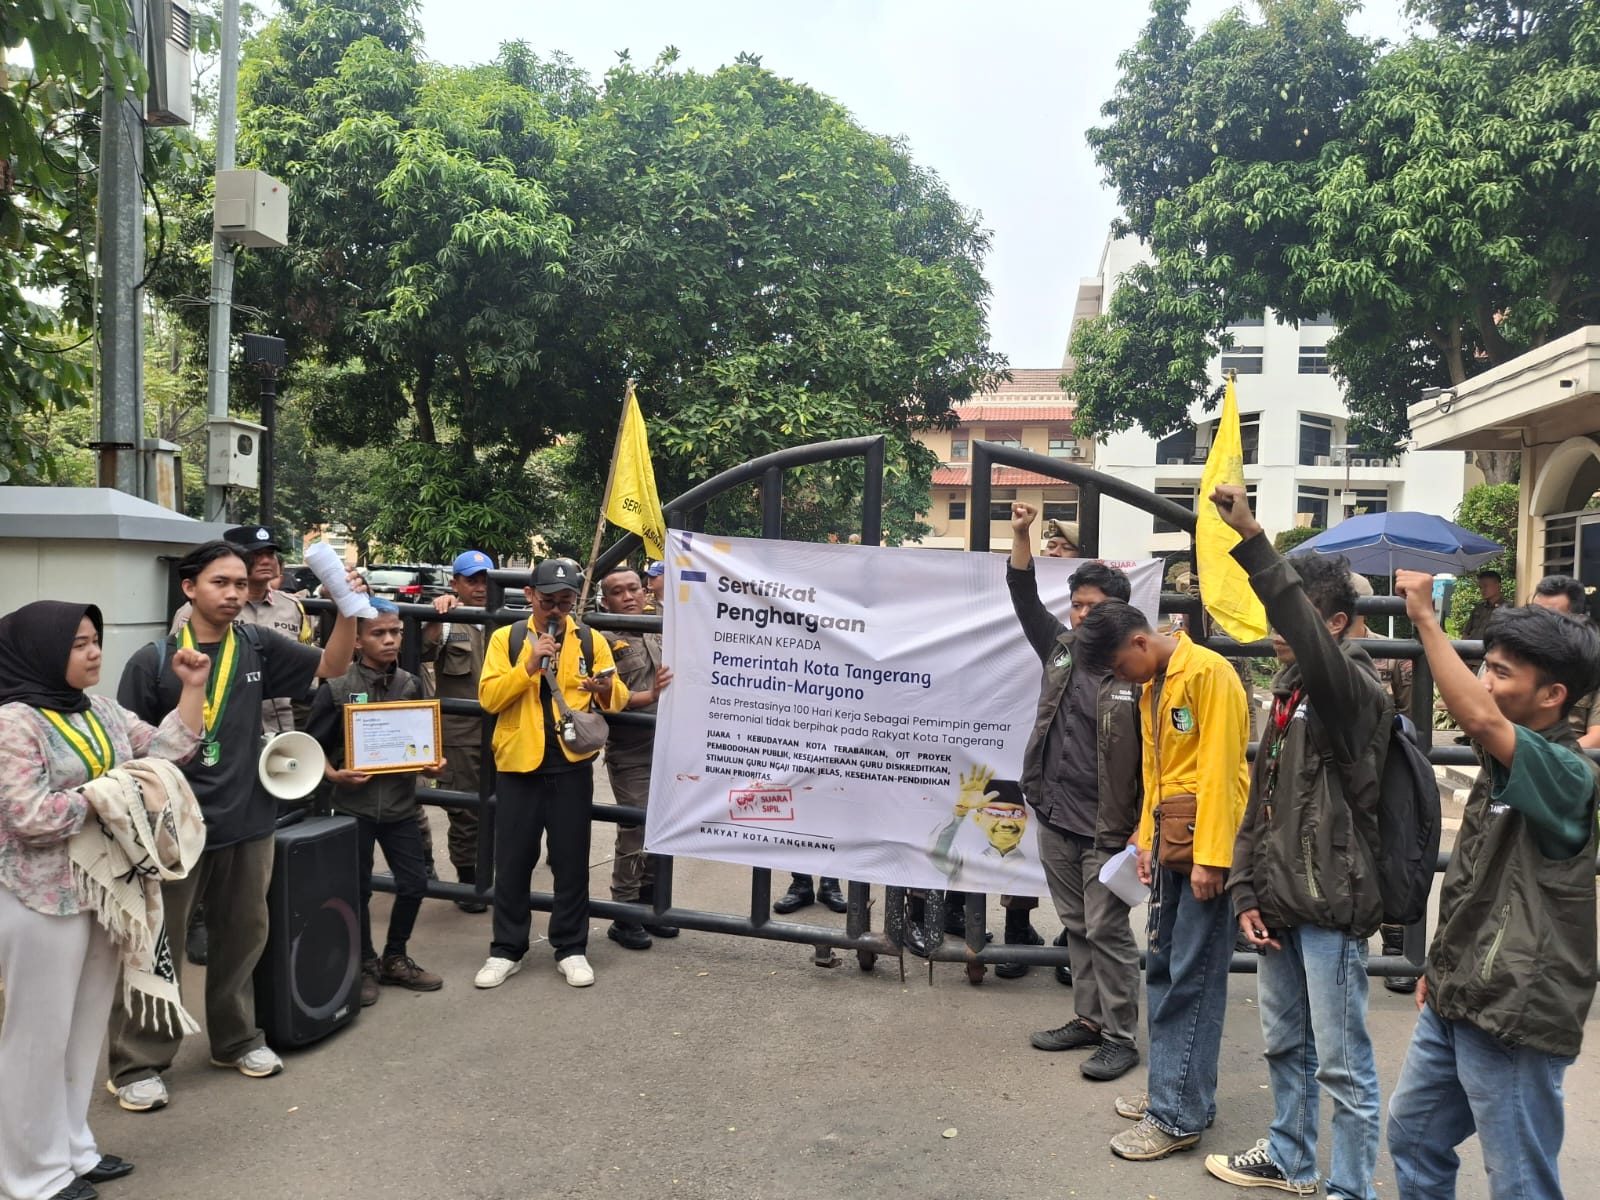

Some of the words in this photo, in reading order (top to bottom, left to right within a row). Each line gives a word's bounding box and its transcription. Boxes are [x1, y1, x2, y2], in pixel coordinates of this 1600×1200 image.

[1110, 561, 1136, 569] SUARA
[718, 576, 817, 603] Sertifikat
[716, 602, 866, 634] Penghargaan
[714, 631, 773, 647] DIBERIKAN
[775, 636, 821, 651] KEPADA
[713, 651, 798, 673] Pemerintah
[804, 660, 839, 677] Kota
[845, 663, 931, 688] Tangerang
[711, 671, 864, 701] Sachrudin-Maryono
[709, 695, 731, 706] Atas
[734, 698, 791, 714] Prestasinya
[793, 704, 809, 714] 100
[812, 707, 833, 717] Hari
[835, 709, 861, 722] Kerja
[863, 712, 910, 727] Sebagai
[912, 716, 970, 731] Pemimpin
[973, 722, 1011, 733] gemar
[708, 710, 763, 724] seremonial
[766, 716, 790, 728] tidak
[793, 719, 839, 733] berpihak
[841, 725, 868, 736] pada
[871, 728, 910, 742] Rakyat
[913, 732, 939, 743] Kota
[942, 734, 1004, 749] Tangerang
[706, 729, 731, 739] JUARA
[747, 734, 799, 748] KEBUDAYAAN
[805, 742, 827, 751] KOTA
[834, 745, 888, 758] TERABAIKAN,
[896, 751, 910, 760] OJT
[917, 752, 952, 762] PROYEK
[706, 742, 760, 755] PEMBODOHAN
[762, 748, 791, 760] PUBLIK,
[793, 752, 858, 767] KESEJAHTERAAN
[860, 760, 883, 769] GURU
[886, 763, 950, 775] DISKREDITKAN,
[705, 765, 731, 776] BUKAN
[733, 769, 773, 781] PRIORITAS.
[706, 754, 744, 765] STIMULUN
[746, 759, 767, 768] GURU
[769, 762, 790, 773] NGAJI
[792, 764, 815, 774] TIDAK
[818, 767, 842, 778] JELAS,
[845, 770, 950, 786] KESEHATAN-PENDIDIKAN
[760, 795, 788, 803] SUARA
[762, 805, 781, 813] SIPIL
[700, 826, 739, 838] RAKYAT
[743, 832, 769, 843] KOTA
[774, 836, 836, 852] TANGERANG
